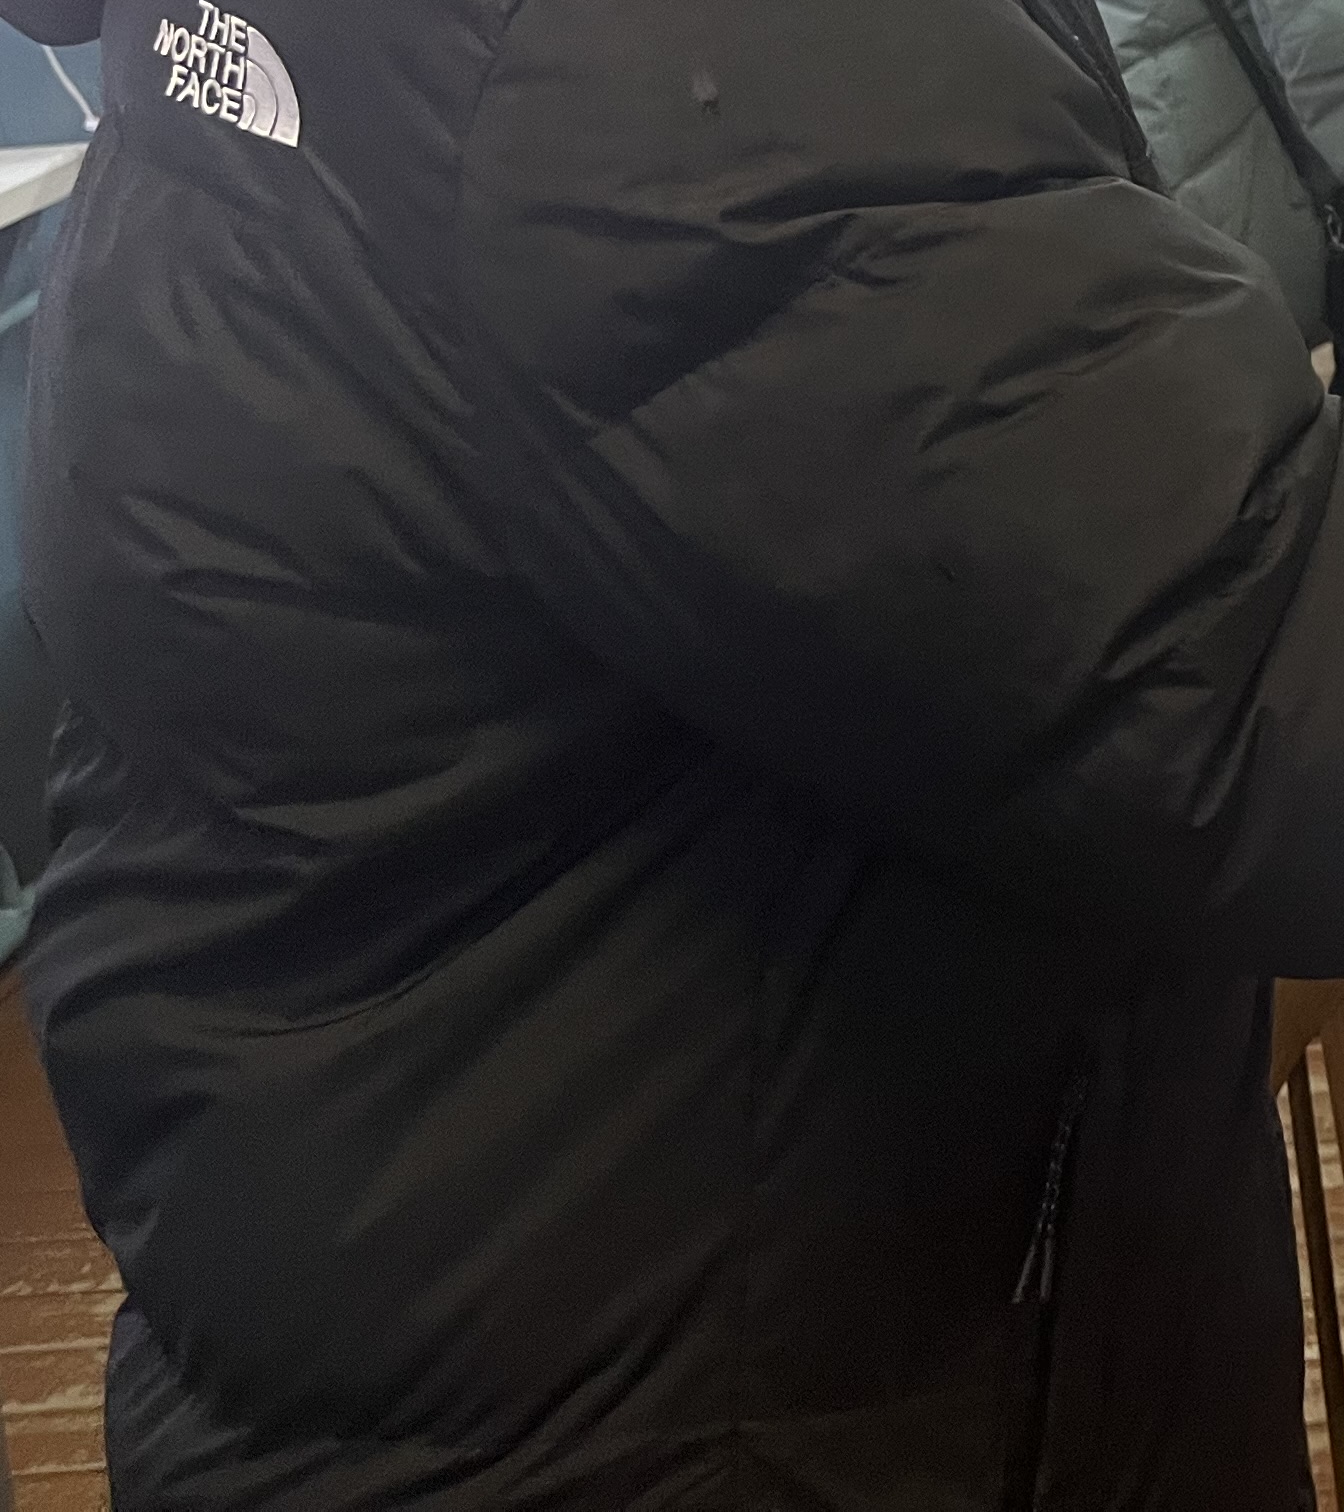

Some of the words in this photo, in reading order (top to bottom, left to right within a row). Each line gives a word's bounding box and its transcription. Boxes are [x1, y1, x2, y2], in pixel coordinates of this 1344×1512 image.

[153, 18, 245, 90] NORTH
[198, 0, 247, 53] THE
[165, 64, 242, 123] FACE
